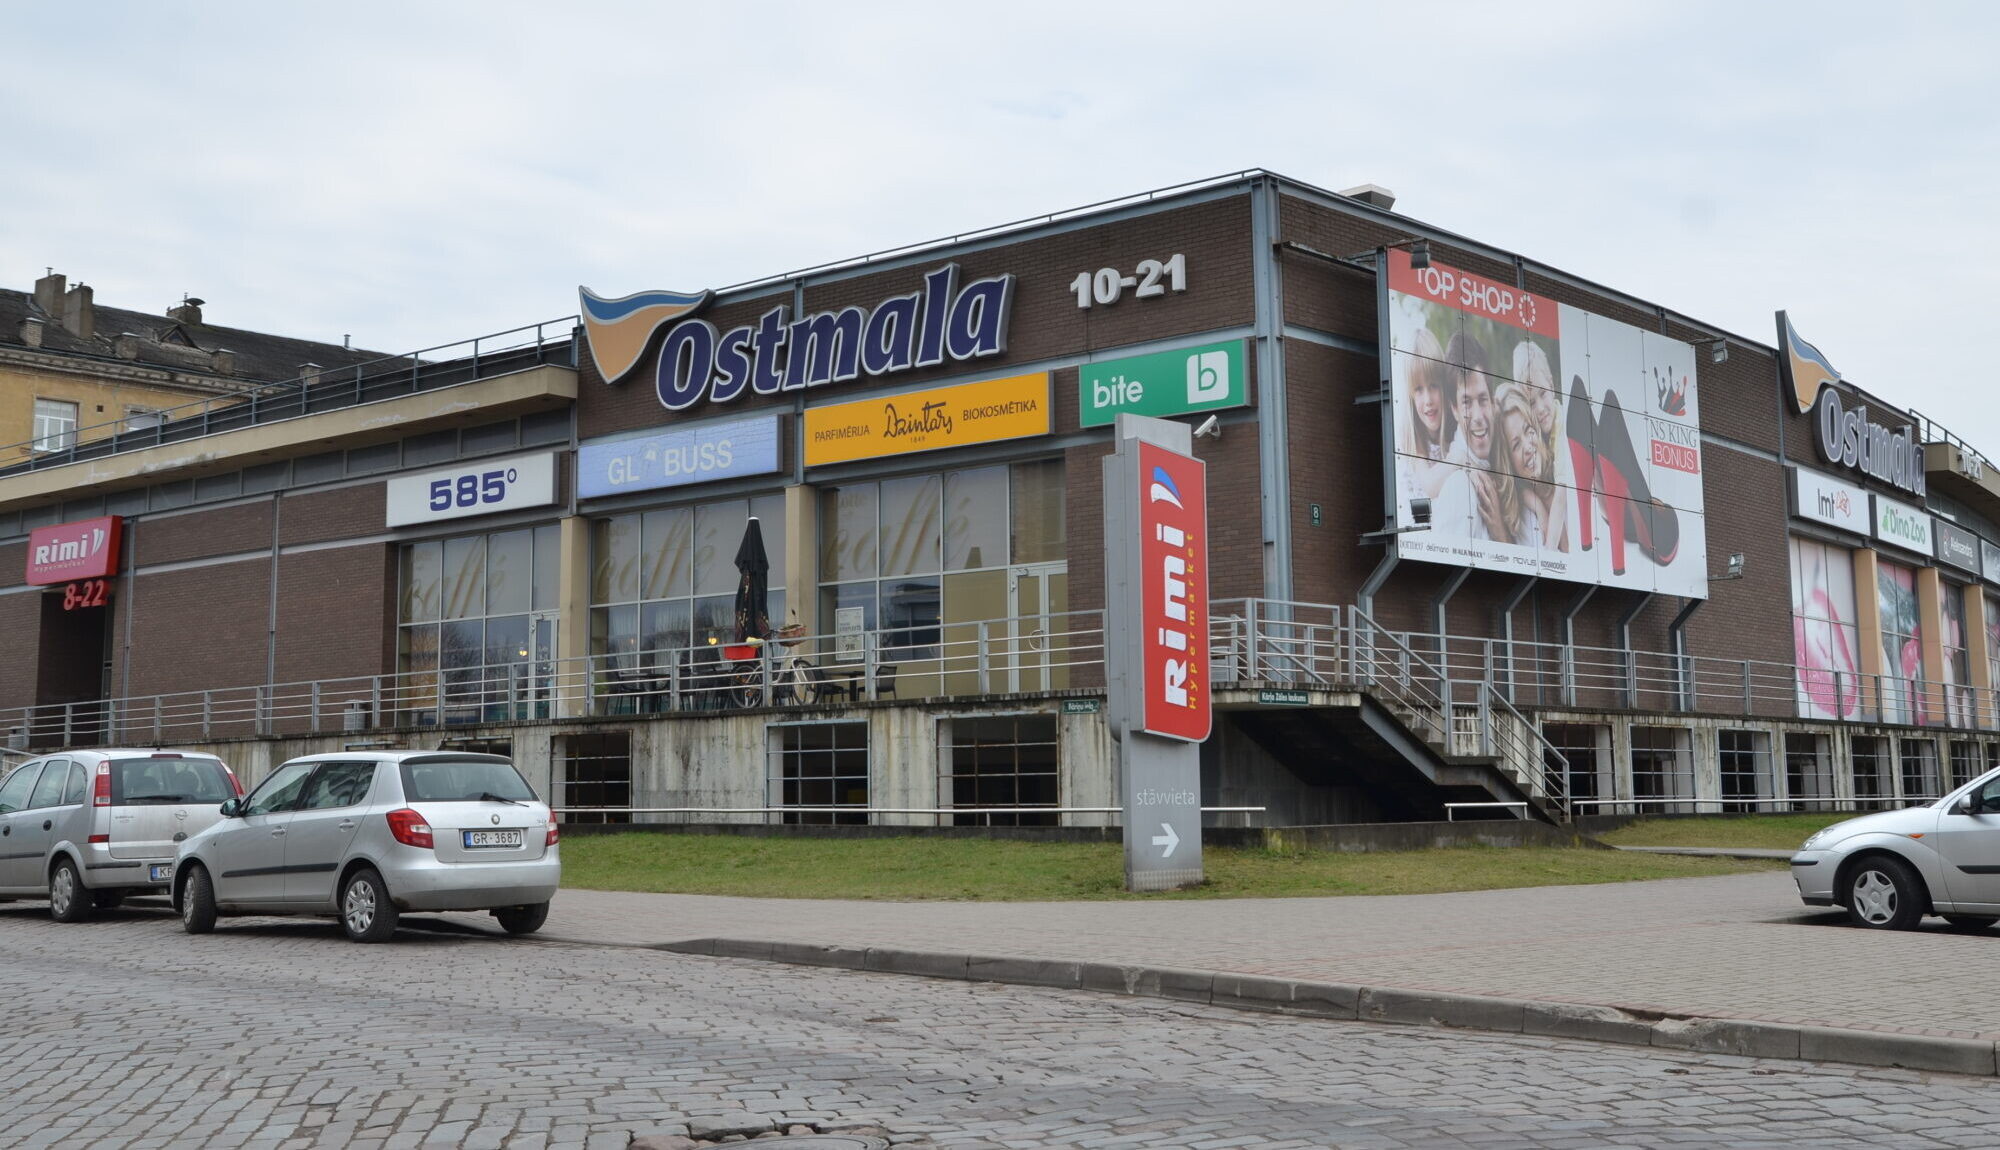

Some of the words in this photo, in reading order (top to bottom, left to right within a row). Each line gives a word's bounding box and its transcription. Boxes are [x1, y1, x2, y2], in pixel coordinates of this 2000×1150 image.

[1070, 253, 1186, 309] 10-21
[1417, 266, 1455, 300] TOP
[1460, 277, 1514, 315] SHOP
[656, 262, 1016, 411] Ostmala
[1093, 375, 1143, 408] bite
[962, 400, 1037, 421] BIOKOSMĒTIKA
[815, 424, 870, 442] PARFIMĒRIJA
[1668, 424, 1697, 448] KING
[1821, 387, 1926, 498] Ostmala
[1654, 443, 1695, 470] BONUS
[1313, 506, 1319, 519] 8
[1889, 508, 1910, 539] Dino
[1910, 515, 1926, 544] Zoo
[34, 533, 88, 565] Rimi
[64, 581, 106, 611] 8-22
[1157, 523, 1188, 707] Rimi
[1186, 532, 1198, 709] Hypermarket
[1136, 787, 1195, 806] stāvvieta
